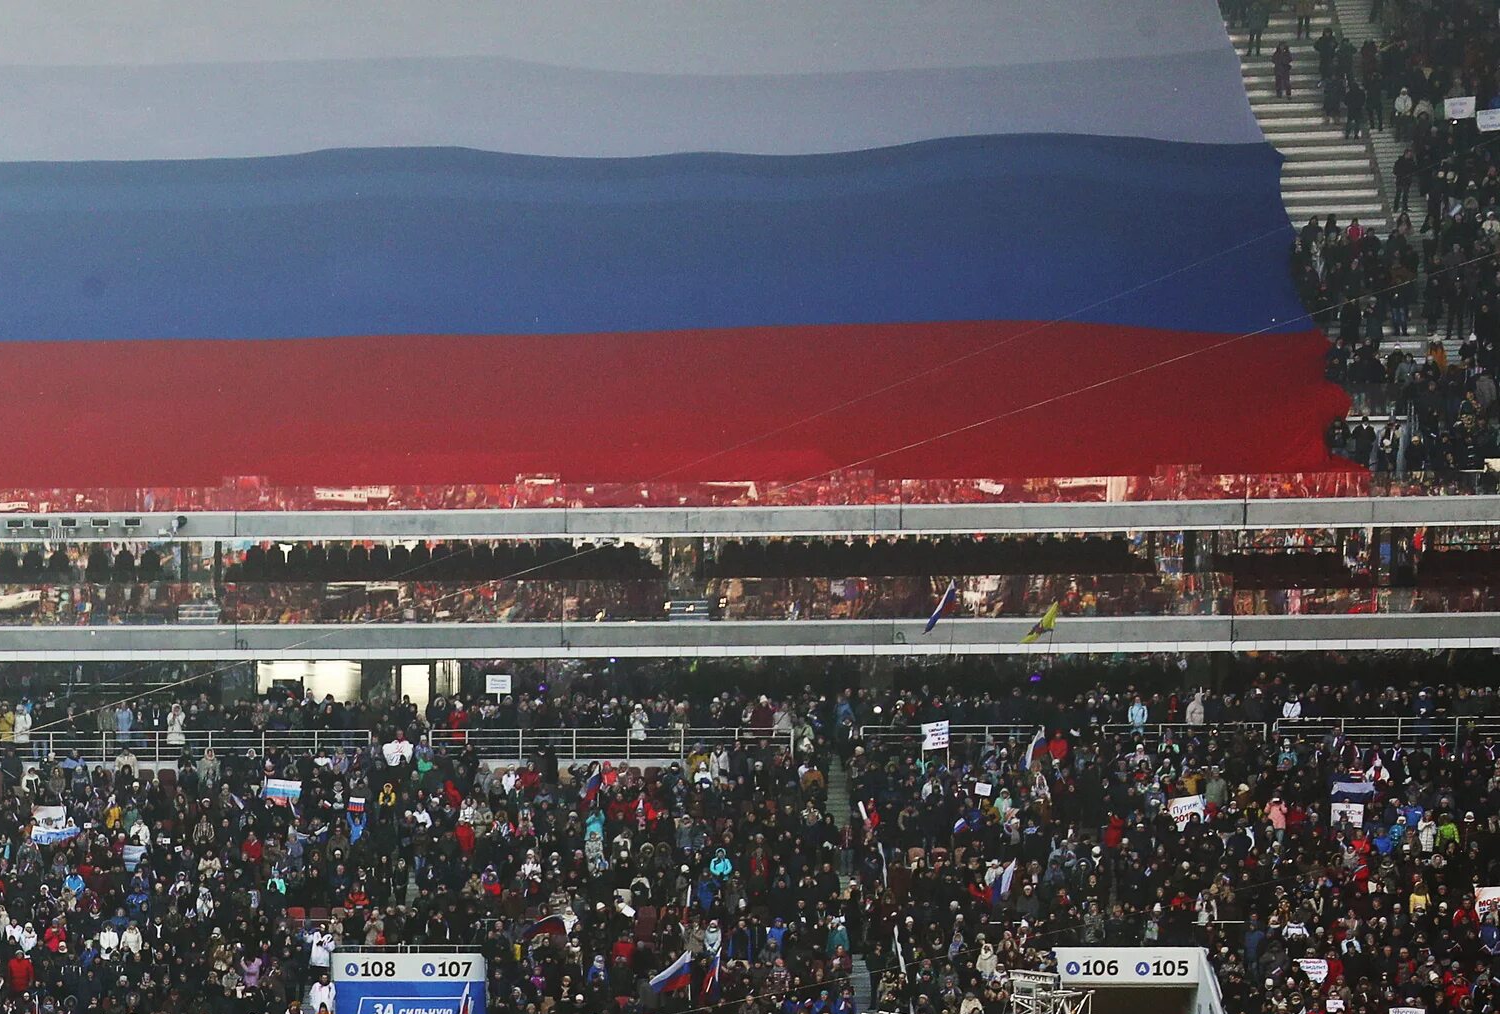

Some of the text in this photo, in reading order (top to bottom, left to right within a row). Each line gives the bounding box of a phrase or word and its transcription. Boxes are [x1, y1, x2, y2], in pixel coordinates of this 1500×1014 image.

[361, 961, 395, 977] 108
[438, 961, 472, 977] 107
[1082, 960, 1118, 976] 106
[1152, 960, 1188, 976] 105
